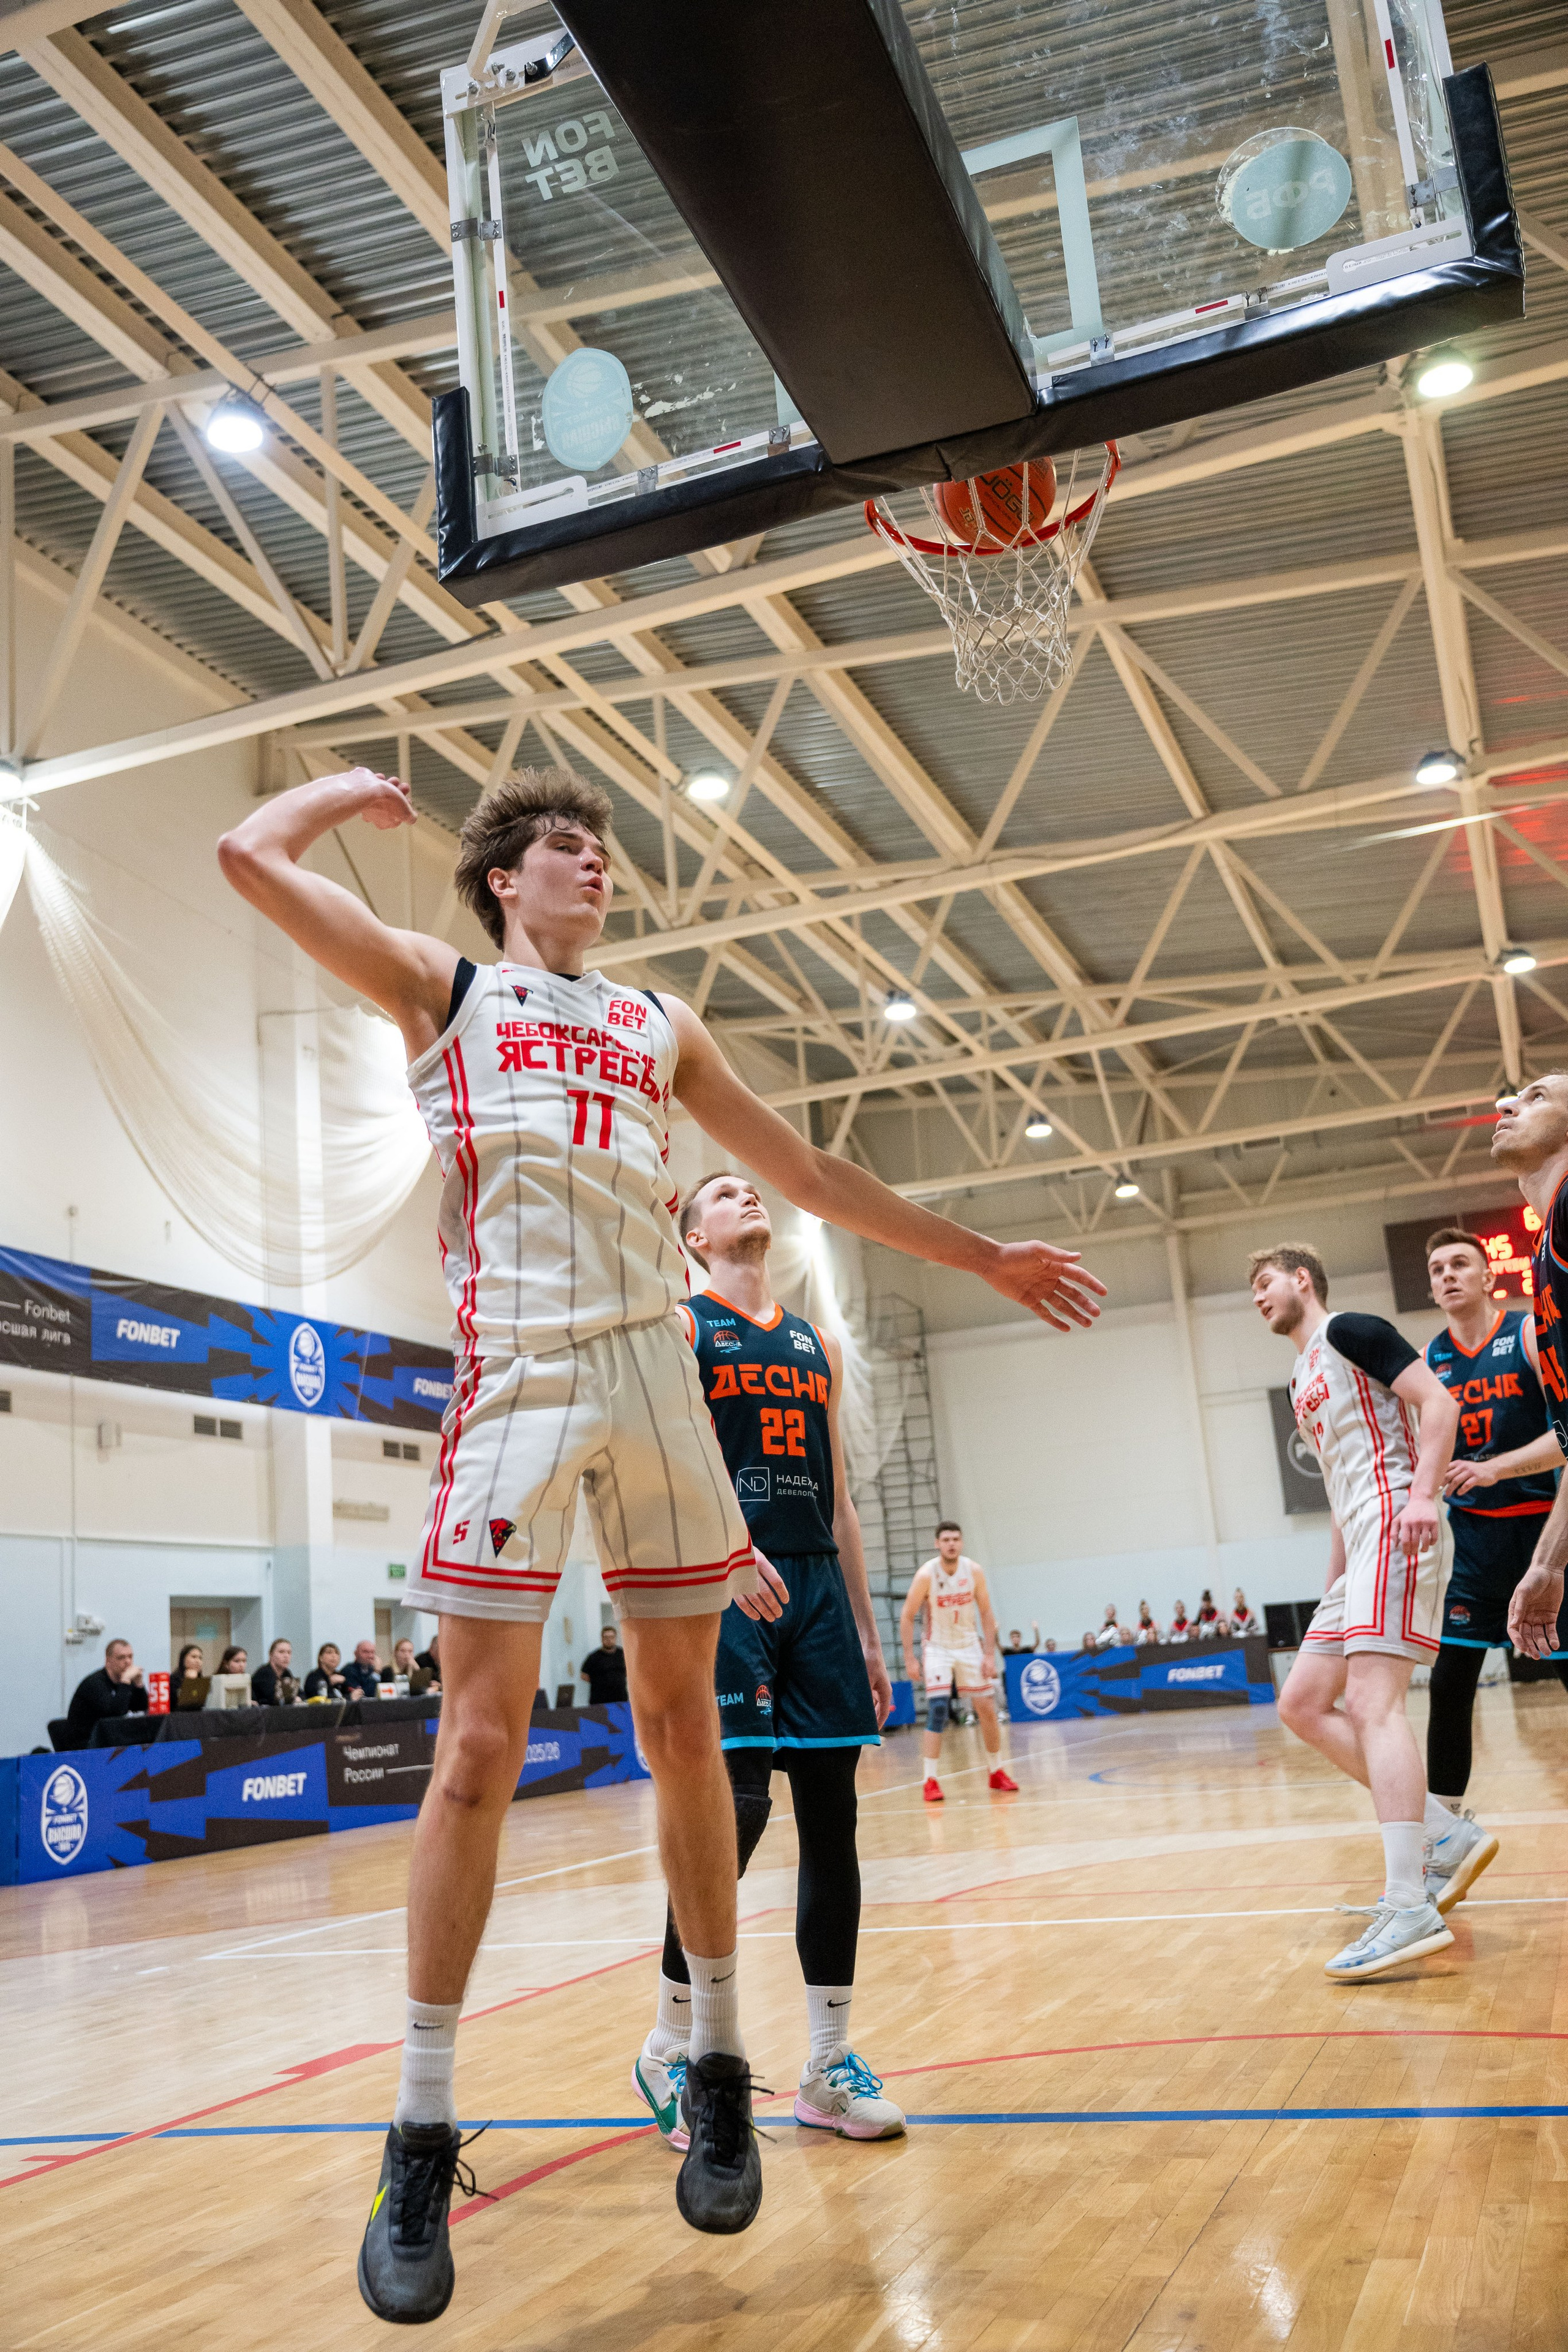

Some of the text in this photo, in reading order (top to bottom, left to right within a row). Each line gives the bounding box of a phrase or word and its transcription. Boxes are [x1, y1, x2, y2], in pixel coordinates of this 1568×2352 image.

[609, 1000, 647, 1019] FON
[607, 1012, 646, 1030] BET
[496, 1039, 660, 1104] ЯСТРЕБЫ
[567, 1090, 616, 1150] 11
[24, 1299, 71, 1324] Fonbet
[706, 1318, 736, 1327] TEAM
[116, 1318, 181, 1349] FONBET
[790, 1330, 813, 1346] FON
[1493, 1335, 1515, 1348] FON
[793, 1339, 816, 1355] BET
[1491, 1344, 1515, 1357] BET
[1447, 1373, 1524, 1406] ЕСНА
[760, 1408, 806, 1457] 22
[1460, 1408, 1493, 1446] 27
[1167, 1665, 1225, 1683] FONBET
[716, 1692, 744, 1707] TEAM
[242, 1772, 307, 1802] FONBET
